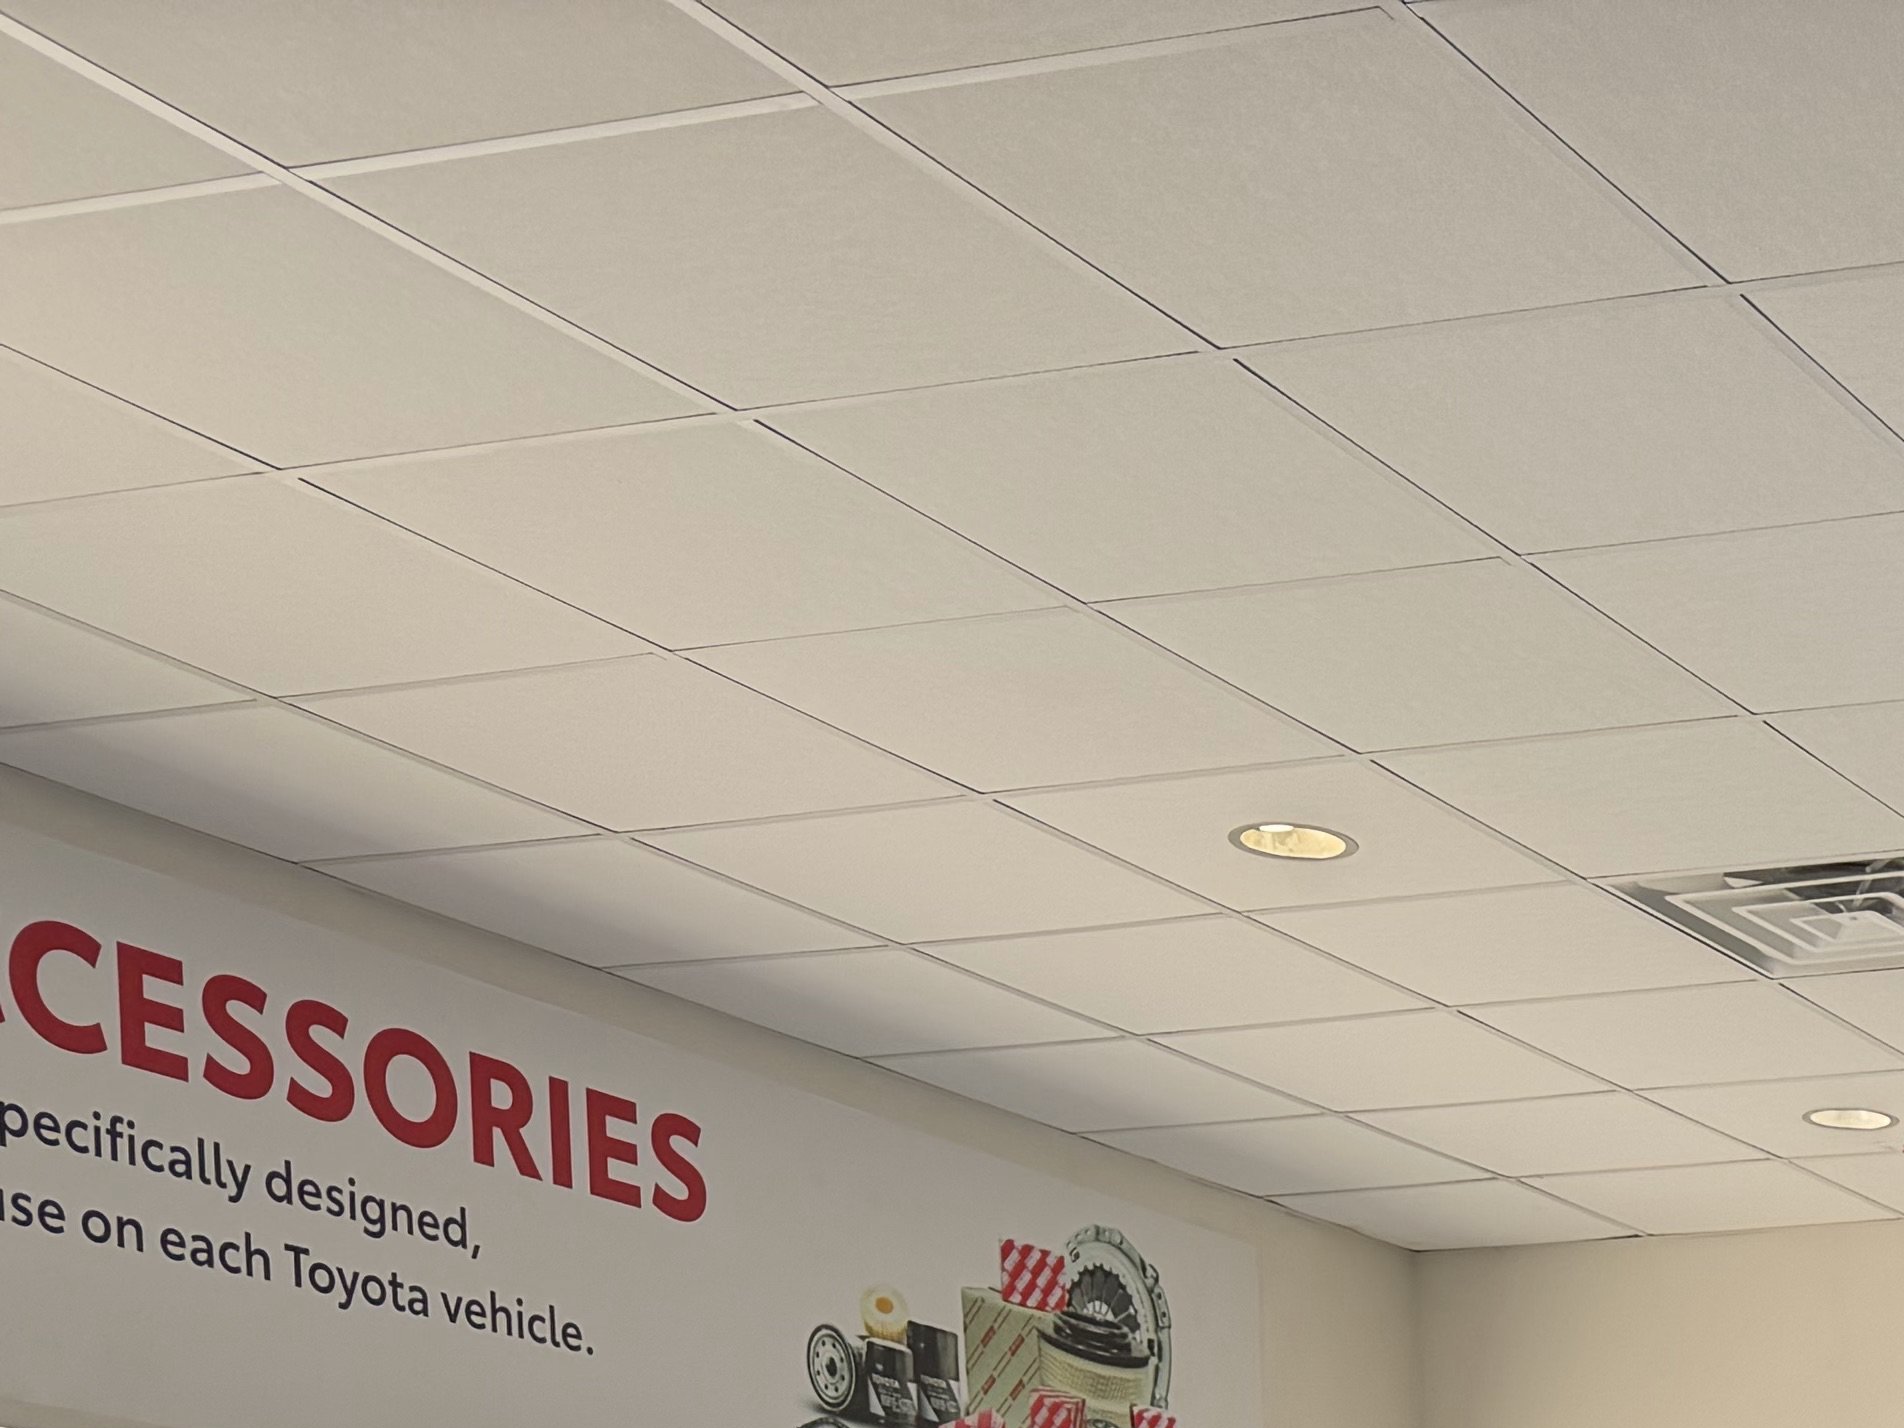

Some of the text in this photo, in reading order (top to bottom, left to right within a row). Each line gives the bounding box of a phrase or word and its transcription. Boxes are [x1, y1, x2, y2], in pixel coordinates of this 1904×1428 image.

[0, 920, 707, 1222] CESSORIES
[81, 1209, 144, 1252] on
[160, 1231, 271, 1288] each
[284, 1243, 429, 1318] Toyota
[440, 1290, 593, 1355] vehicle.
[265, 1160, 480, 1259] designed,
